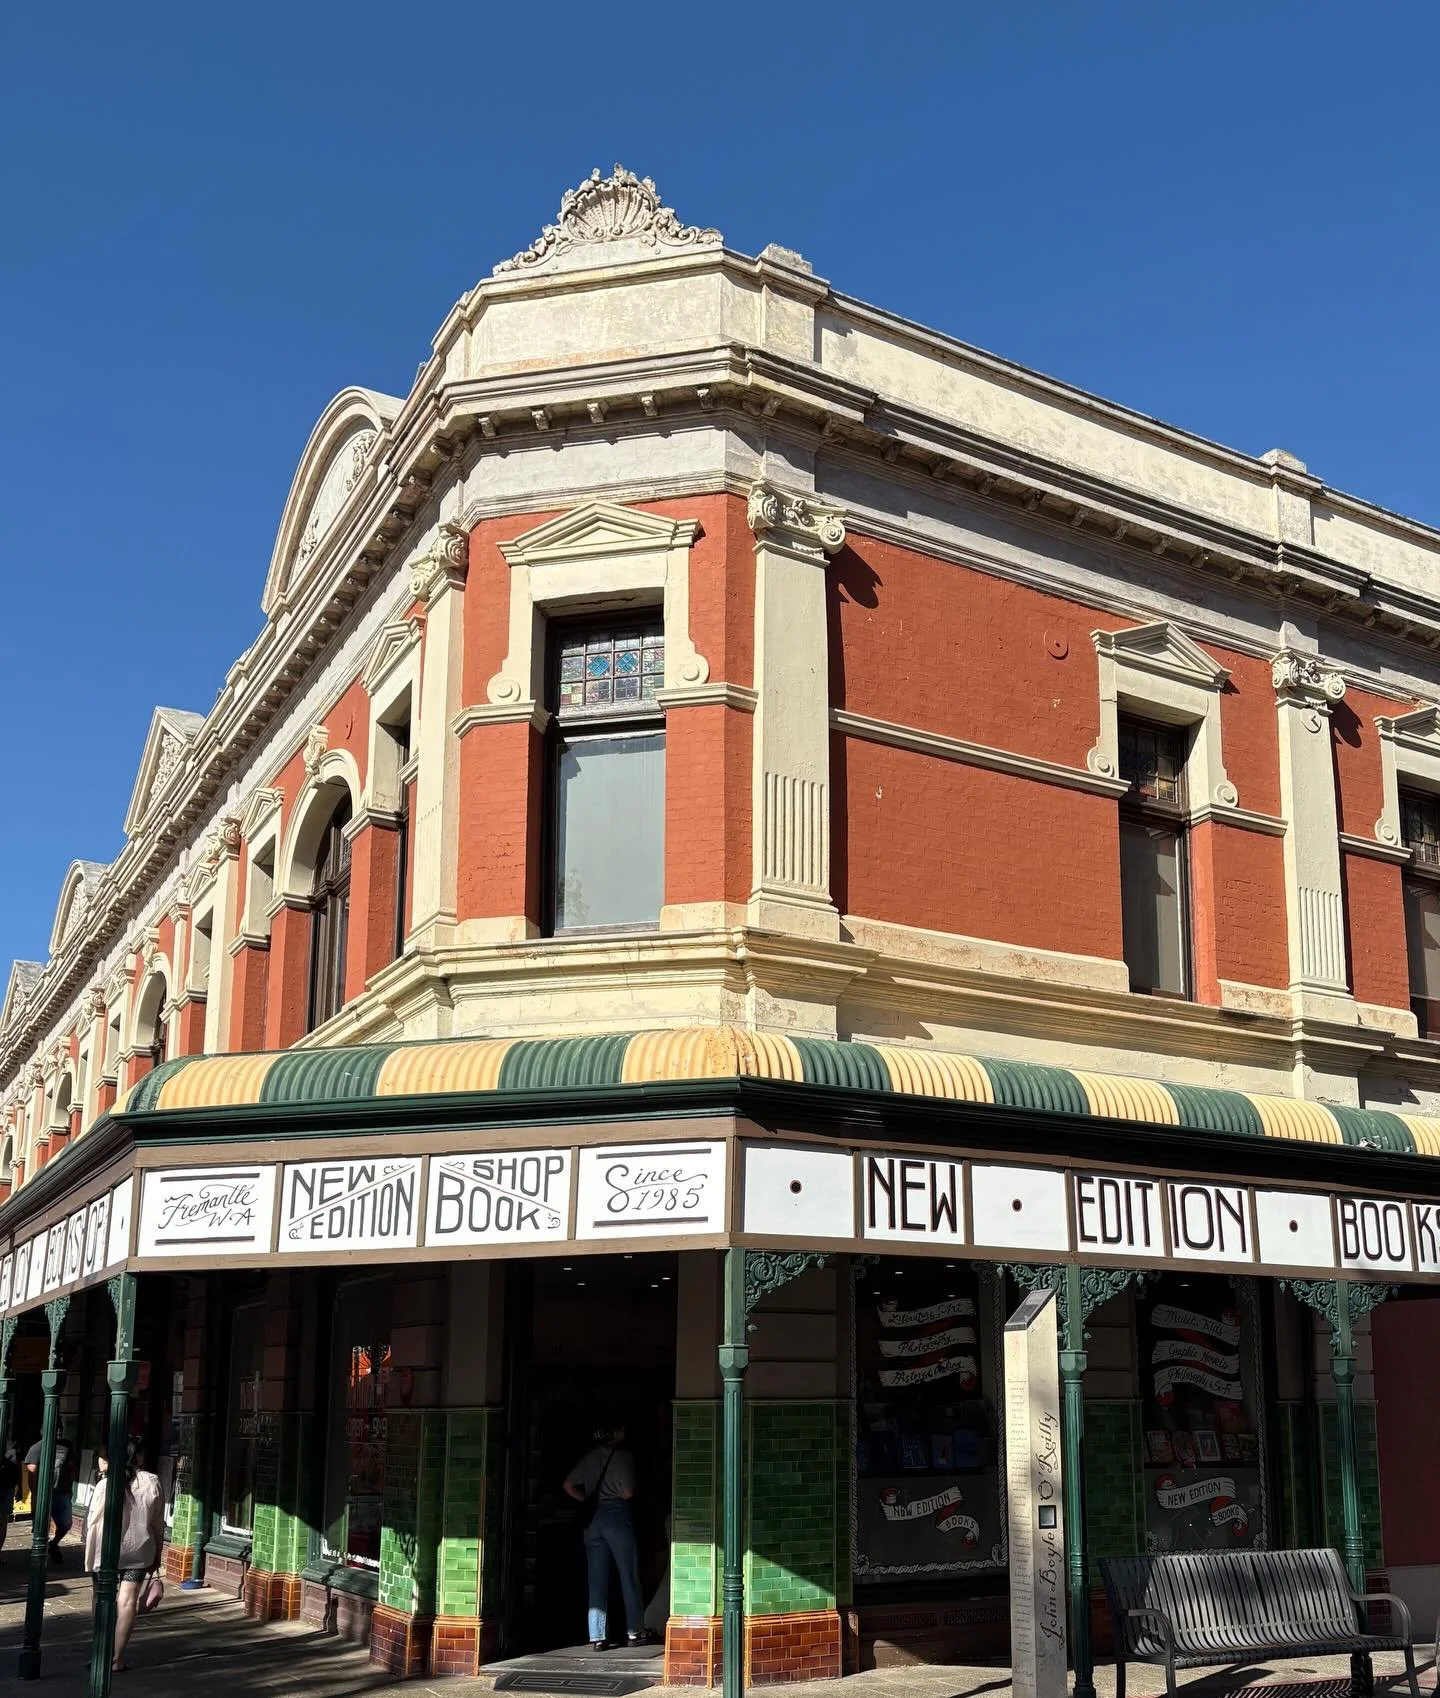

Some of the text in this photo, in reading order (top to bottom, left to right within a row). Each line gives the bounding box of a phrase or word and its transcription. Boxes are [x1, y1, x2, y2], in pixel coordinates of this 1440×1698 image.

[290, 1165, 375, 1219] NEW
[473, 1156, 564, 1202] SHOP
[605, 1164, 713, 1213] Since
[632, 1183, 705, 1211] 1985
[158, 1184, 258, 1229] Fremantle
[310, 1172, 415, 1240] EDITION
[435, 1171, 540, 1233] BOOK
[867, 1157, 1440, 1264] NEW EDITION BOOK
[1168, 1343, 1228, 1369] Graphic Novels
[917, 1492, 950, 1515] EDITION
[1167, 1482, 1221, 1506] NEW EDITION
[1218, 1507, 1240, 1520] BOOKS
[945, 1516, 976, 1530] BOOKS
[1036, 1412, 1064, 1649] John Boyle O'Reilly
